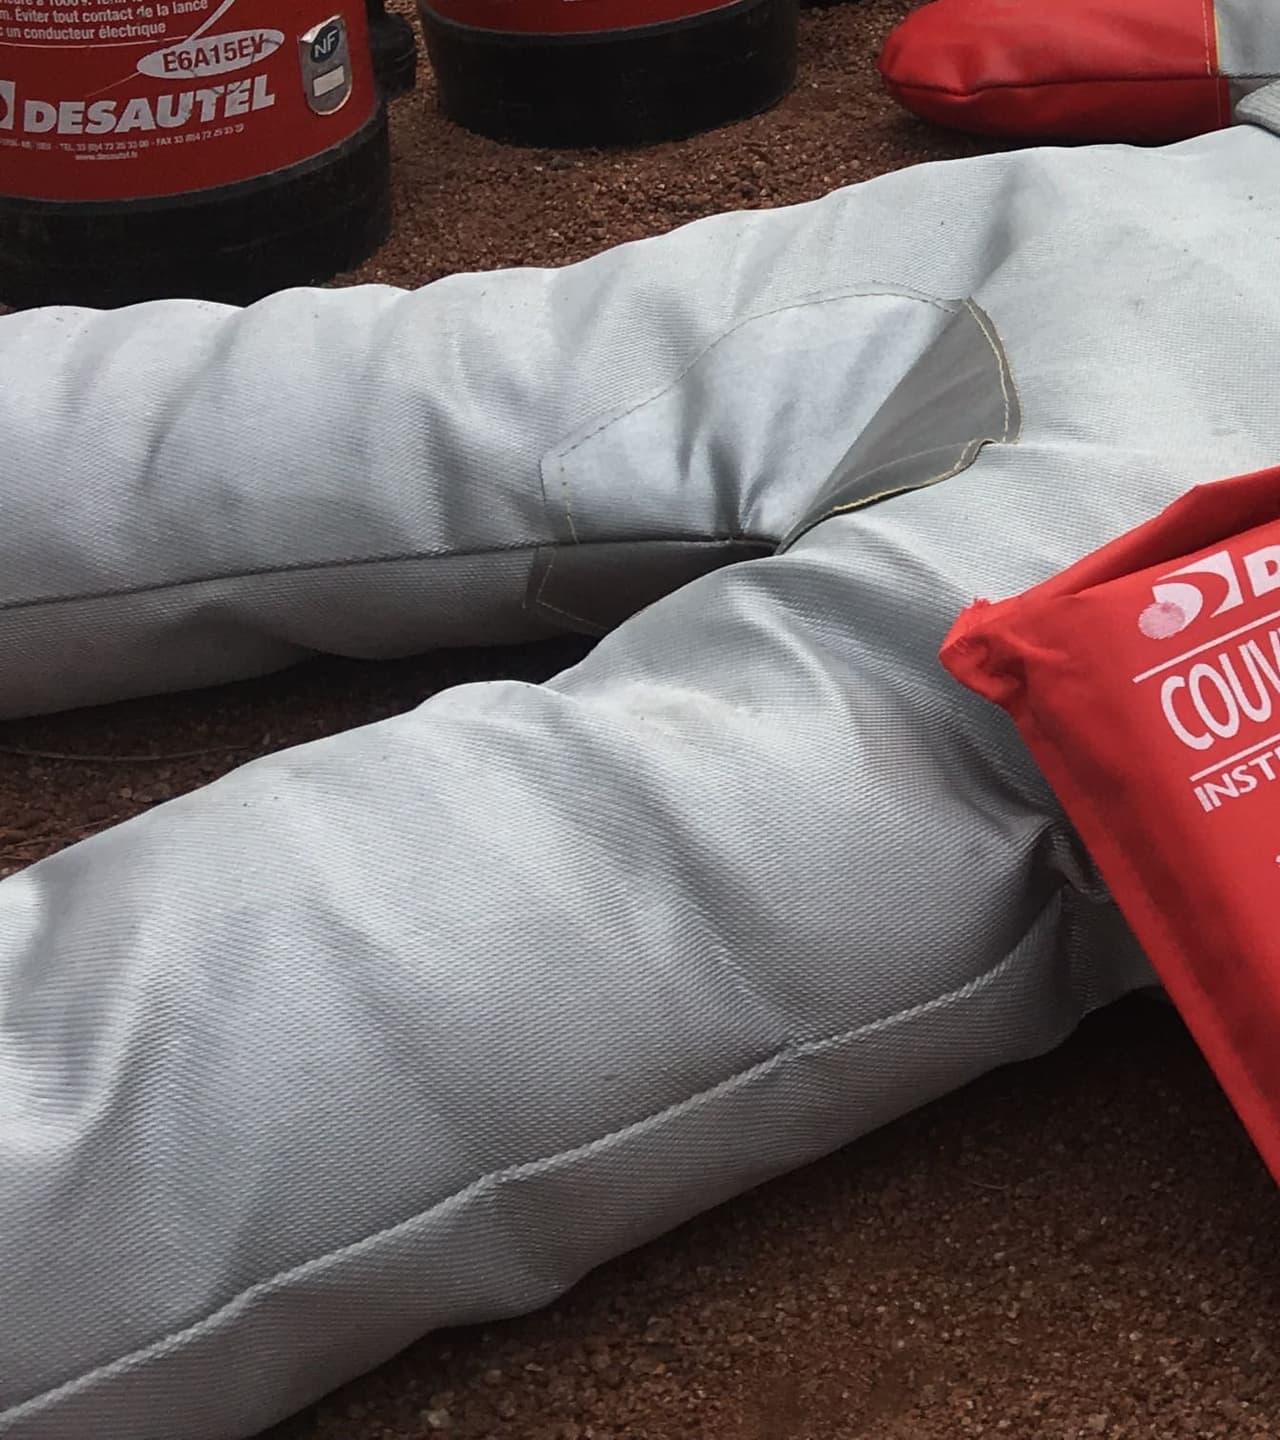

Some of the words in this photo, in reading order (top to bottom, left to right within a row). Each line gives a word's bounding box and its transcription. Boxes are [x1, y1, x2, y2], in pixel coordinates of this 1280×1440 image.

[23, 24, 95, 41] conducteur
[312, 31, 338, 59] NF
[162, 32, 267, 74] E6A15EV
[23, 73, 276, 135] DESAUTEL
